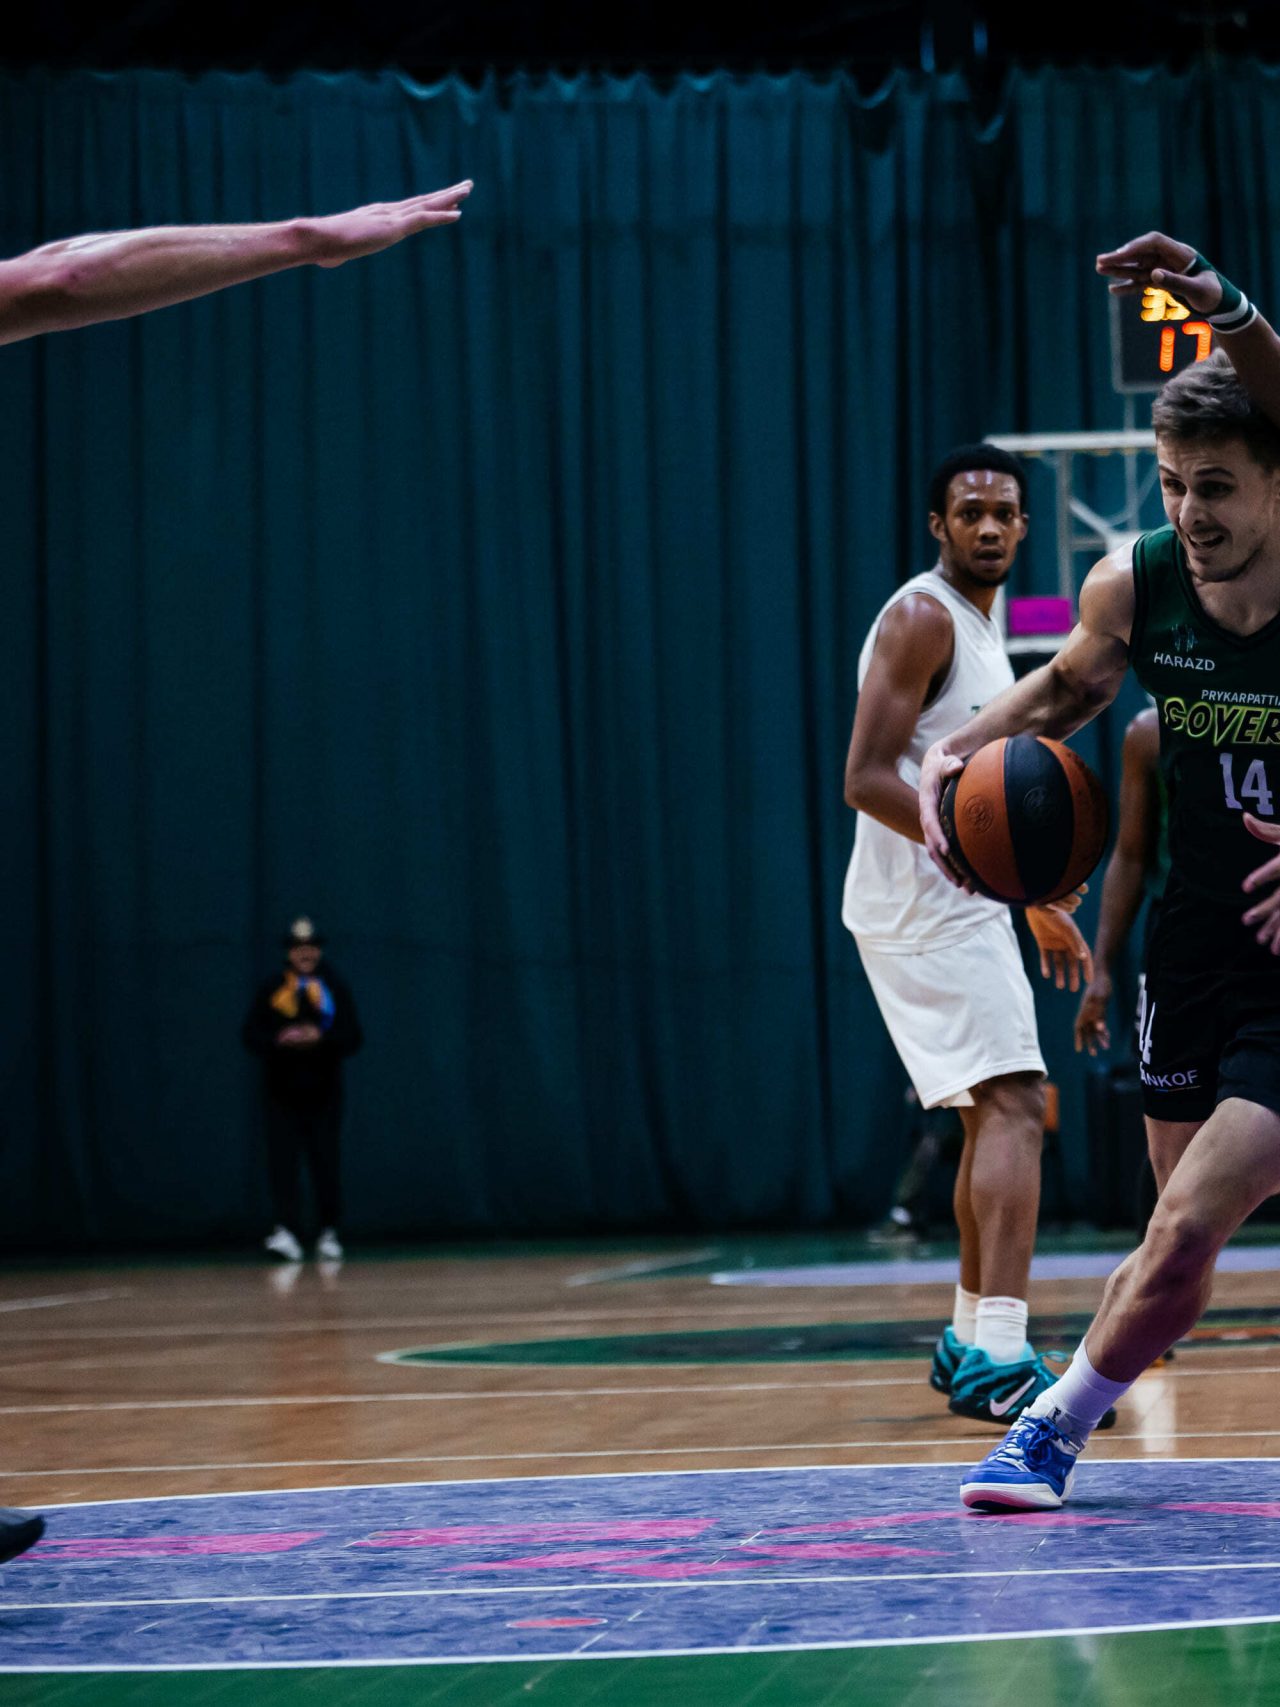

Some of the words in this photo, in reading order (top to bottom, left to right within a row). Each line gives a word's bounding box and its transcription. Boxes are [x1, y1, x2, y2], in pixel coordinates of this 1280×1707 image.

[1160, 321, 1212, 372] 17
[1153, 652, 1216, 671] HARAZD
[1219, 752, 1274, 815] 14
